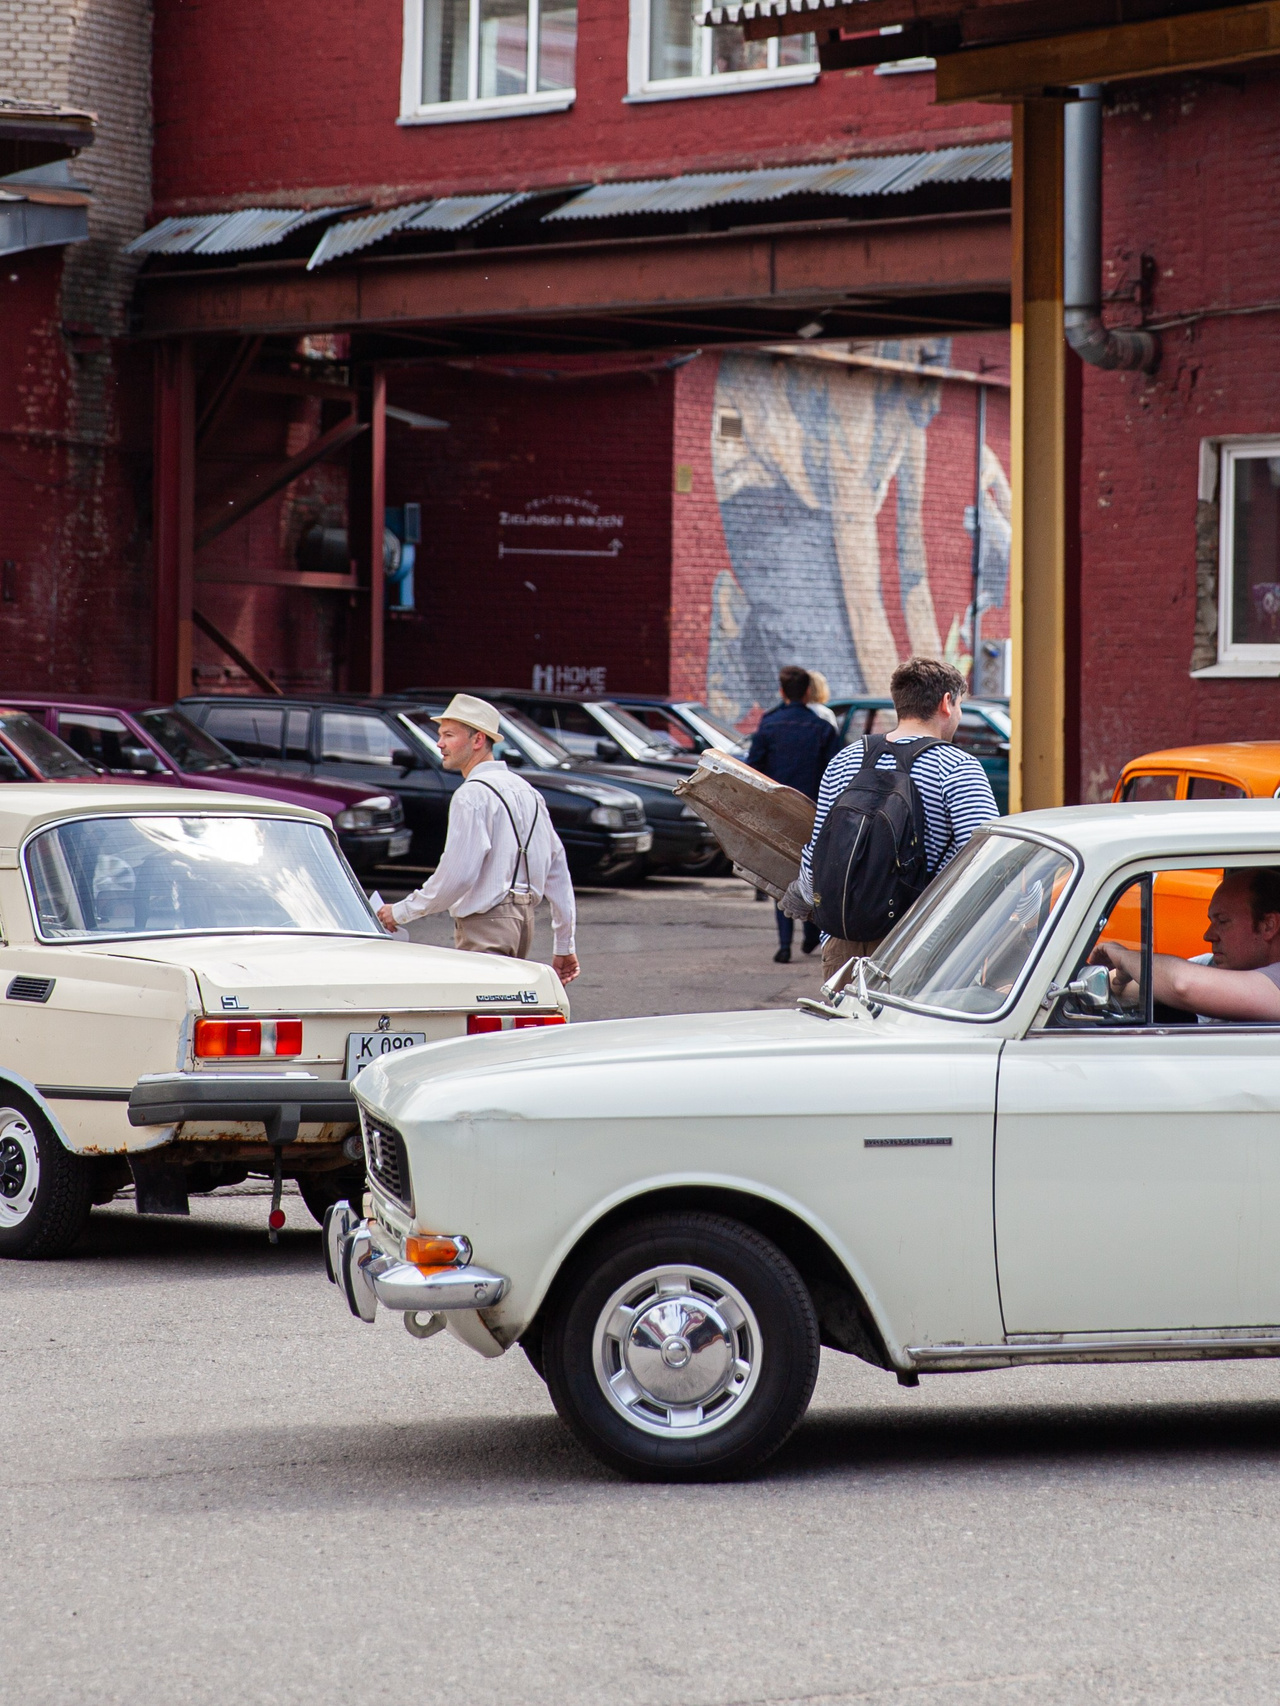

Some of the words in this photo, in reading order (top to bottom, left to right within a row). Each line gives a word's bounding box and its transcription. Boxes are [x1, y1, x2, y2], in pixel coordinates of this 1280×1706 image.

[563, 514, 575, 526] &
[556, 666, 607, 685] HOME
[221, 995, 249, 1010] SL
